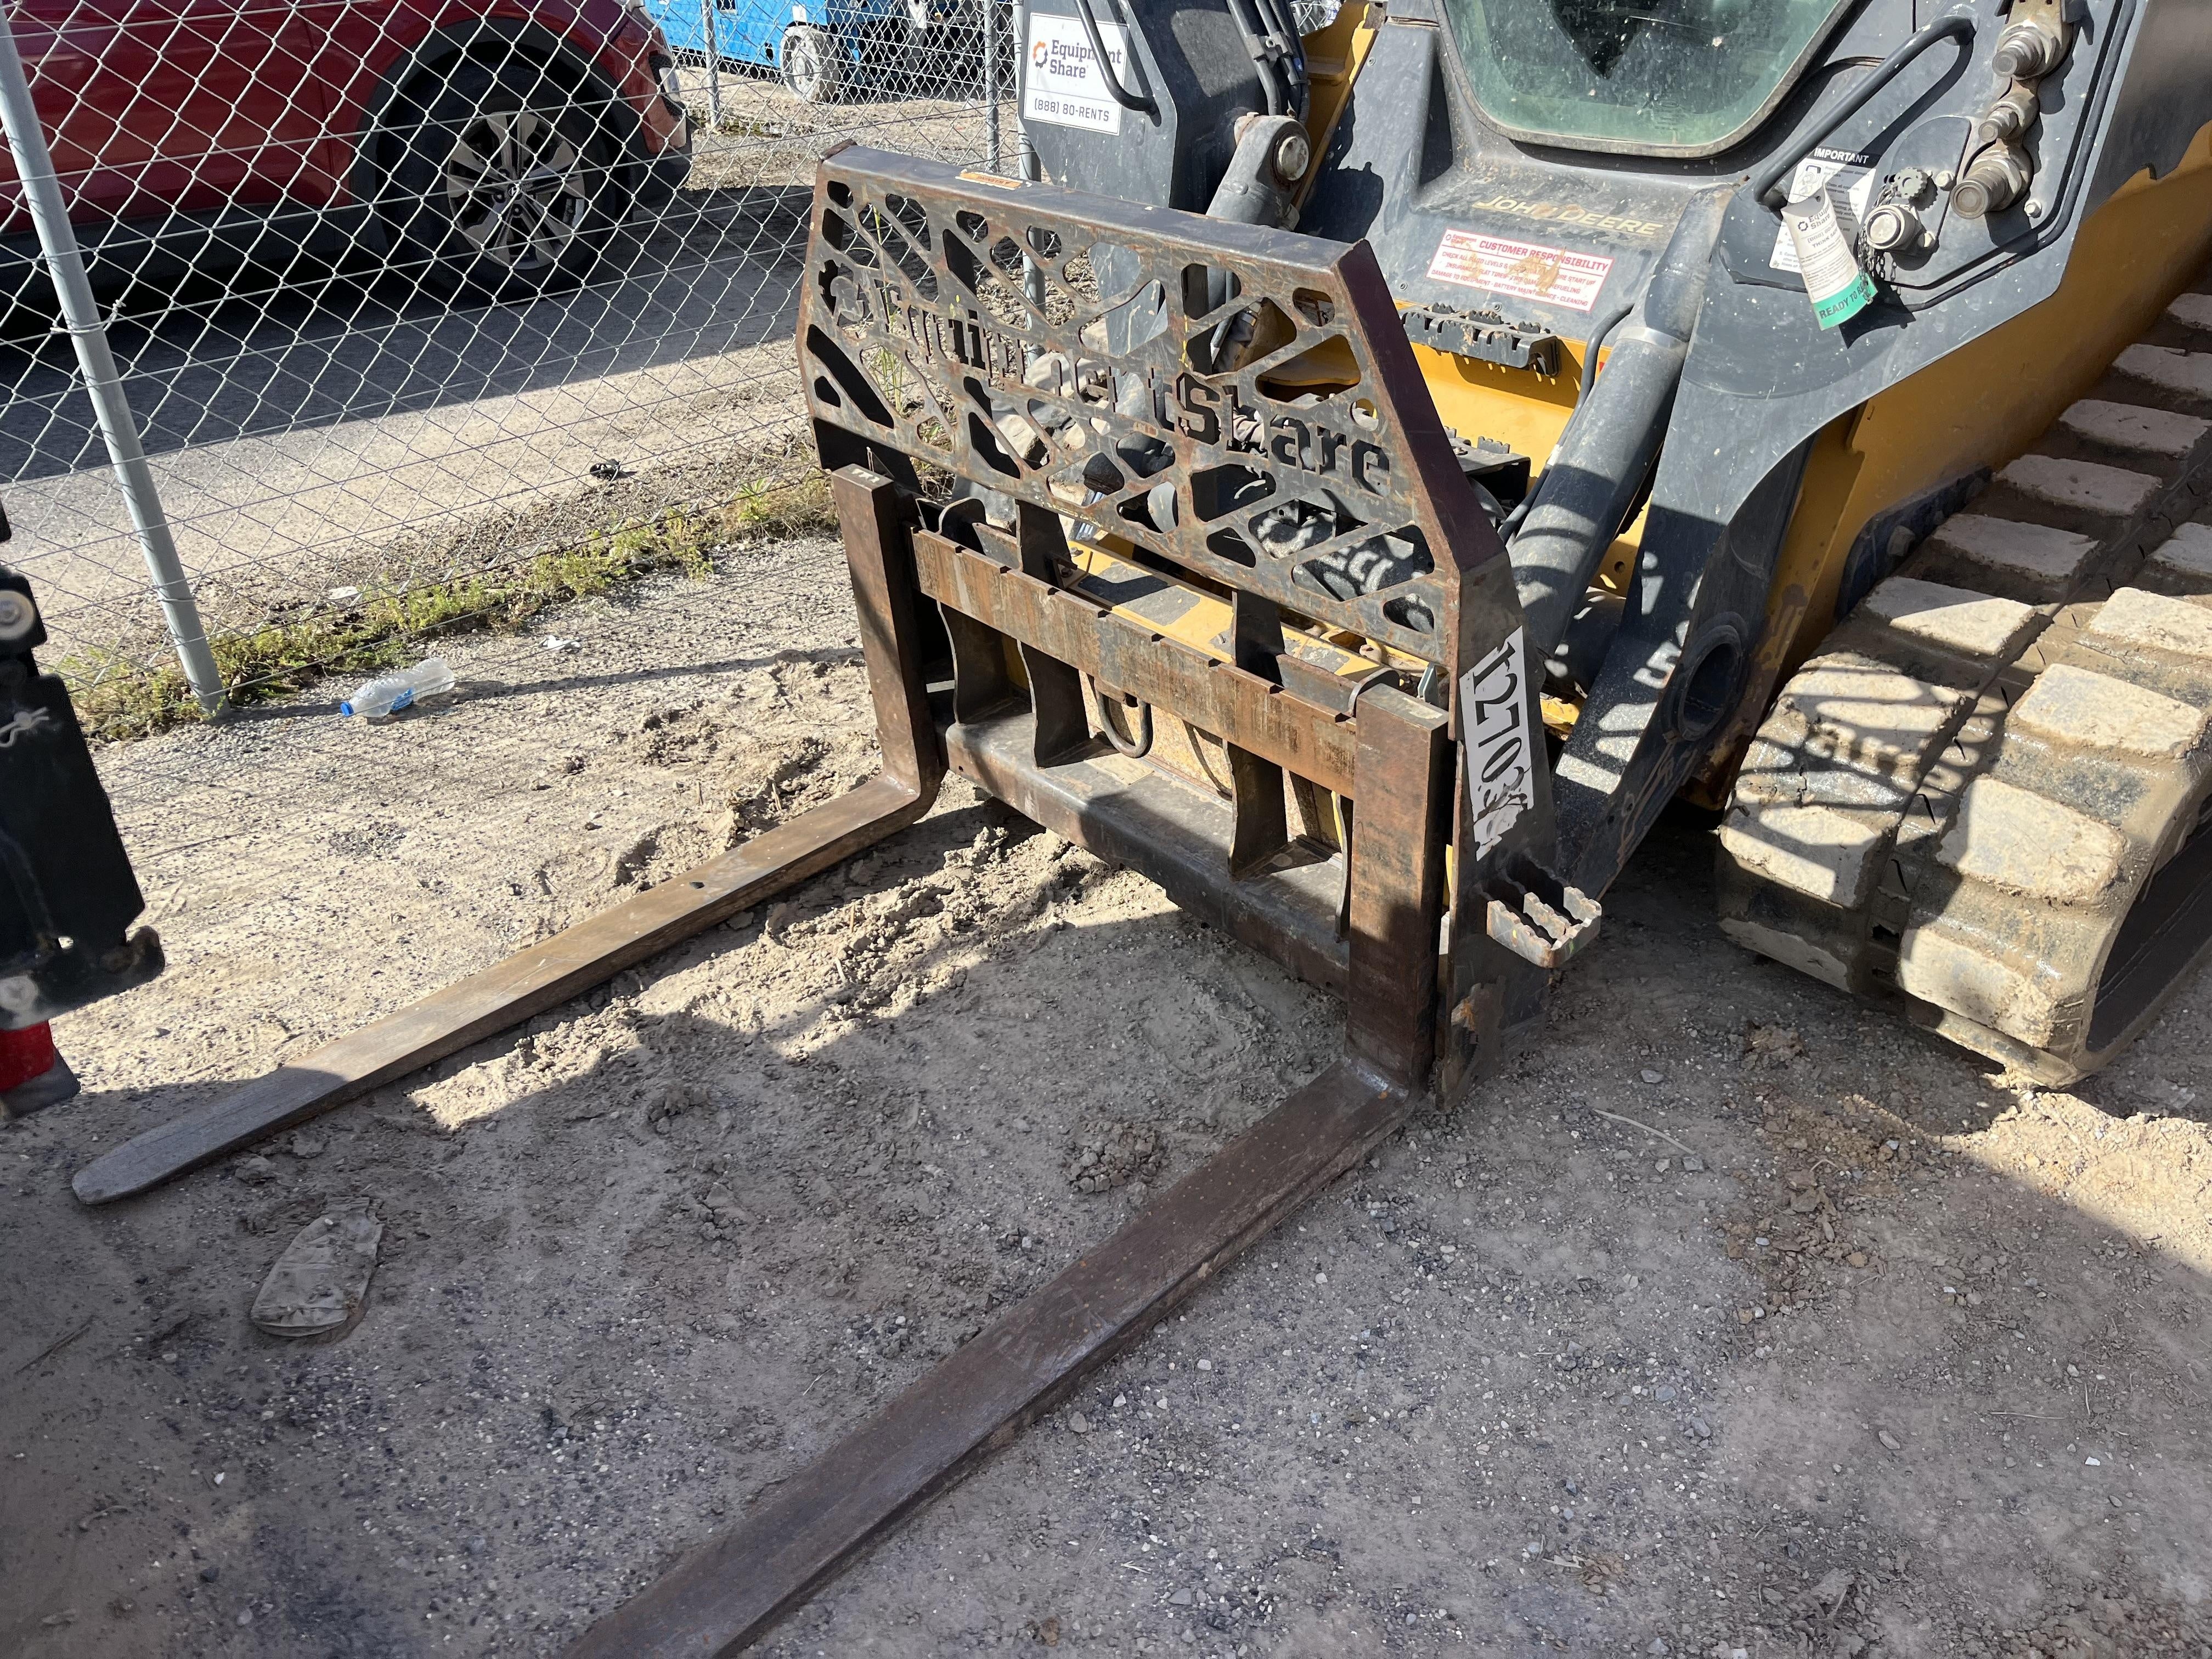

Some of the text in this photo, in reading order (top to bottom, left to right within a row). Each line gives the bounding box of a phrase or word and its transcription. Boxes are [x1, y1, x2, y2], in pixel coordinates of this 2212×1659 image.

[1051, 40, 1122, 64] Equipmnt
[1050, 59, 1086, 78] Share
[1035, 98, 1109, 122] (888) 80-RENTS
[1814, 148, 1869, 163] IMPORTANT
[1476, 195, 1664, 235] JOH DEERE
[1479, 240, 1528, 256] CUSTOMER
[1431, 269, 1452, 278] DAMAGE
[1494, 282, 1517, 291] BATTERY
[1518, 287, 1556, 300] MAINTNCE
[1560, 296, 1588, 306] CLEANING
[1819, 296, 1849, 319] READY
[1849, 291, 1858, 302] TO
